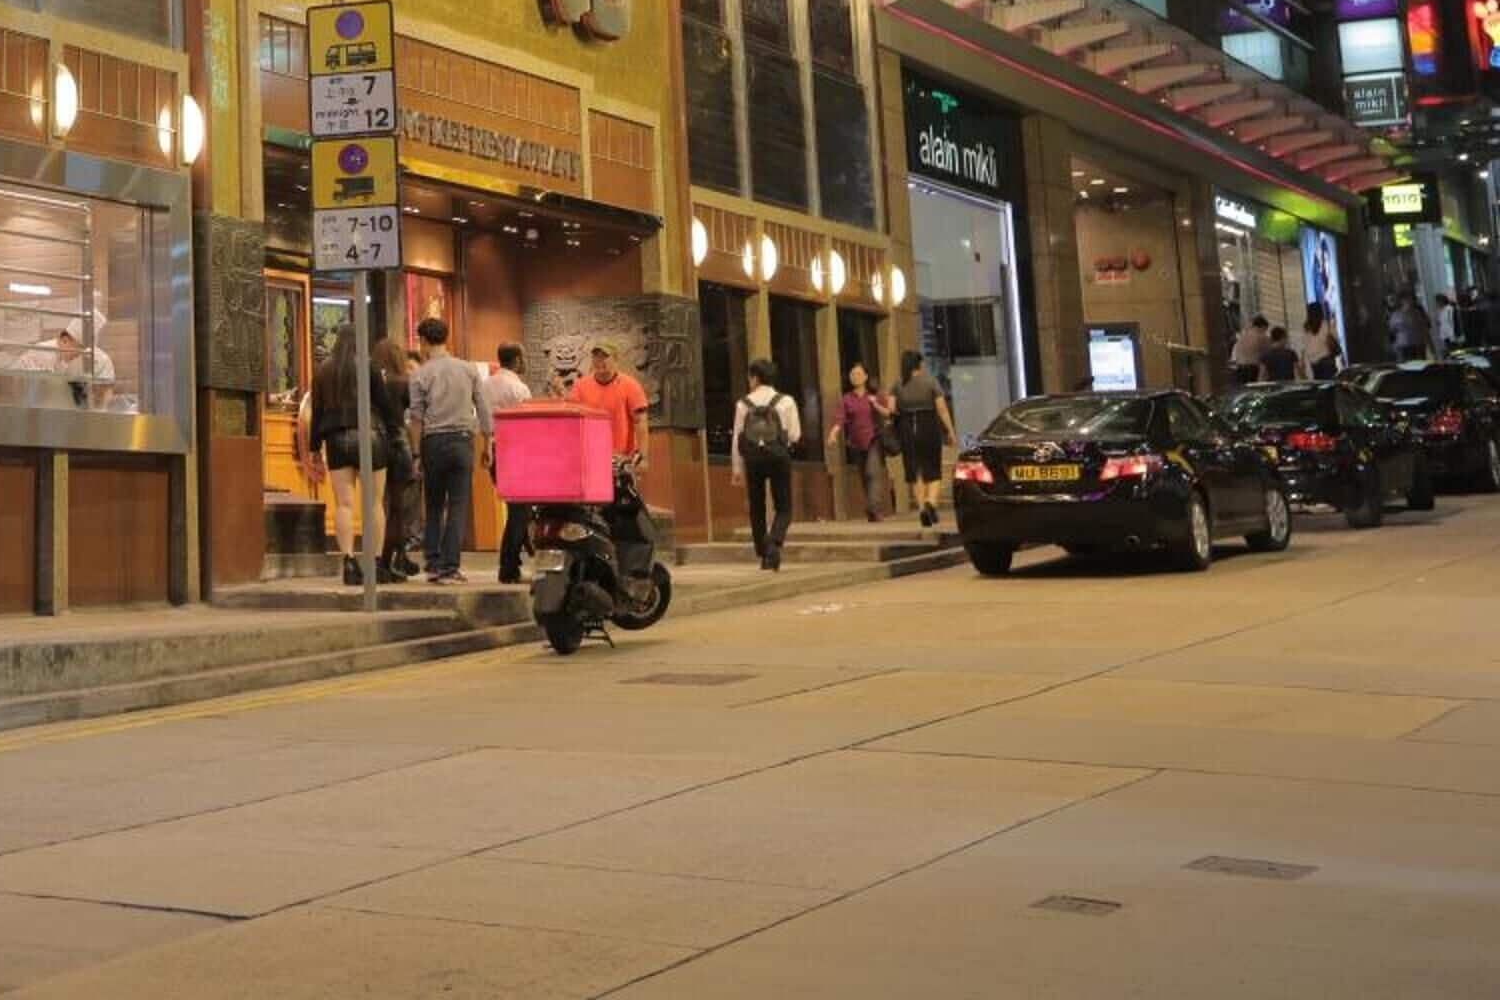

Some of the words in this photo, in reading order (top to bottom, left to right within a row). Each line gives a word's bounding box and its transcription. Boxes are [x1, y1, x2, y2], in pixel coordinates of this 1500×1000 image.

[362, 76, 377, 95] 7
[364, 108, 389, 128] 12
[919, 124, 959, 176] alain
[963, 142, 997, 187] mikli
[347, 214, 394, 233] 7-10
[345, 243, 382, 265] 4-7
